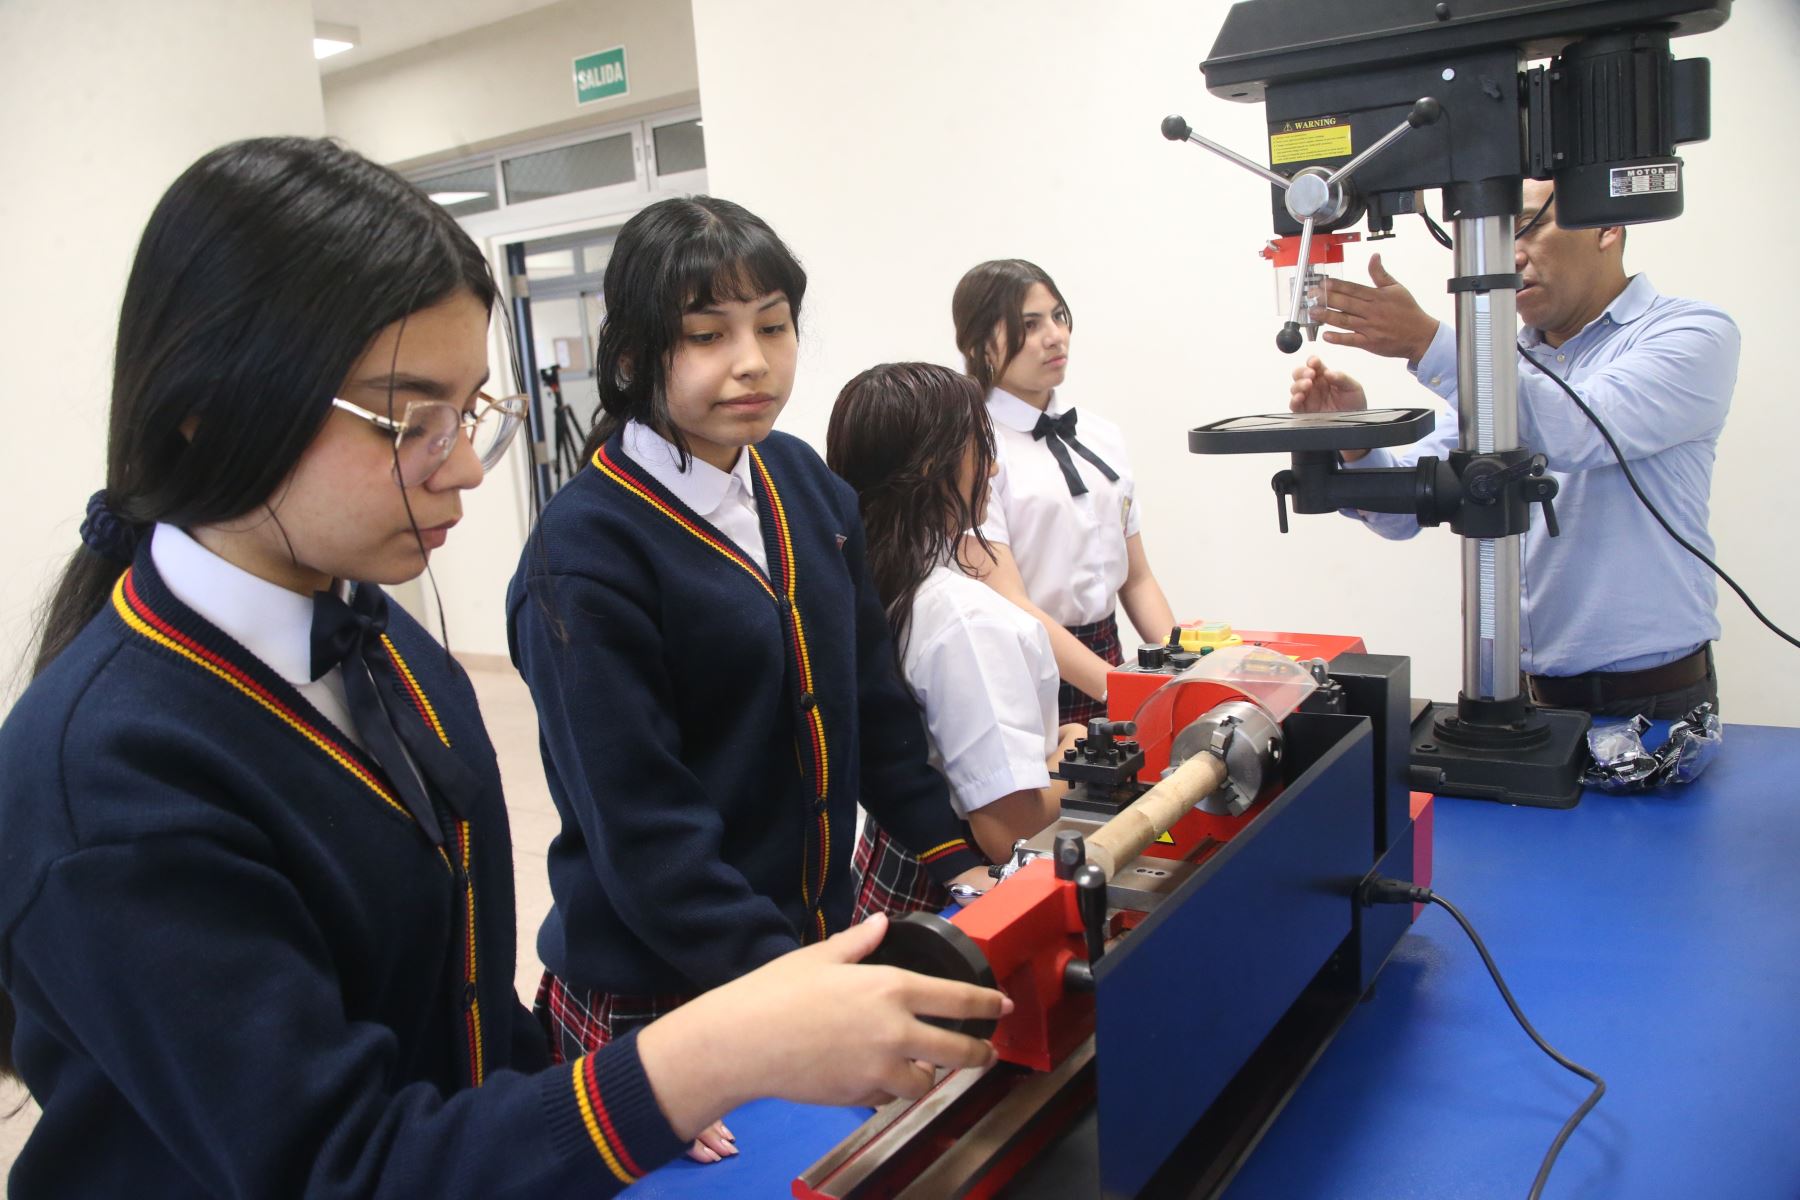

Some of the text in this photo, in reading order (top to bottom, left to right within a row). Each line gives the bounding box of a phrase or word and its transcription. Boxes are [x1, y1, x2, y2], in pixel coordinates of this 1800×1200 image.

[578, 62, 623, 90] SALIDA
[1295, 117, 1337, 130] WARNING
[1627, 168, 1664, 176] MOTOR
